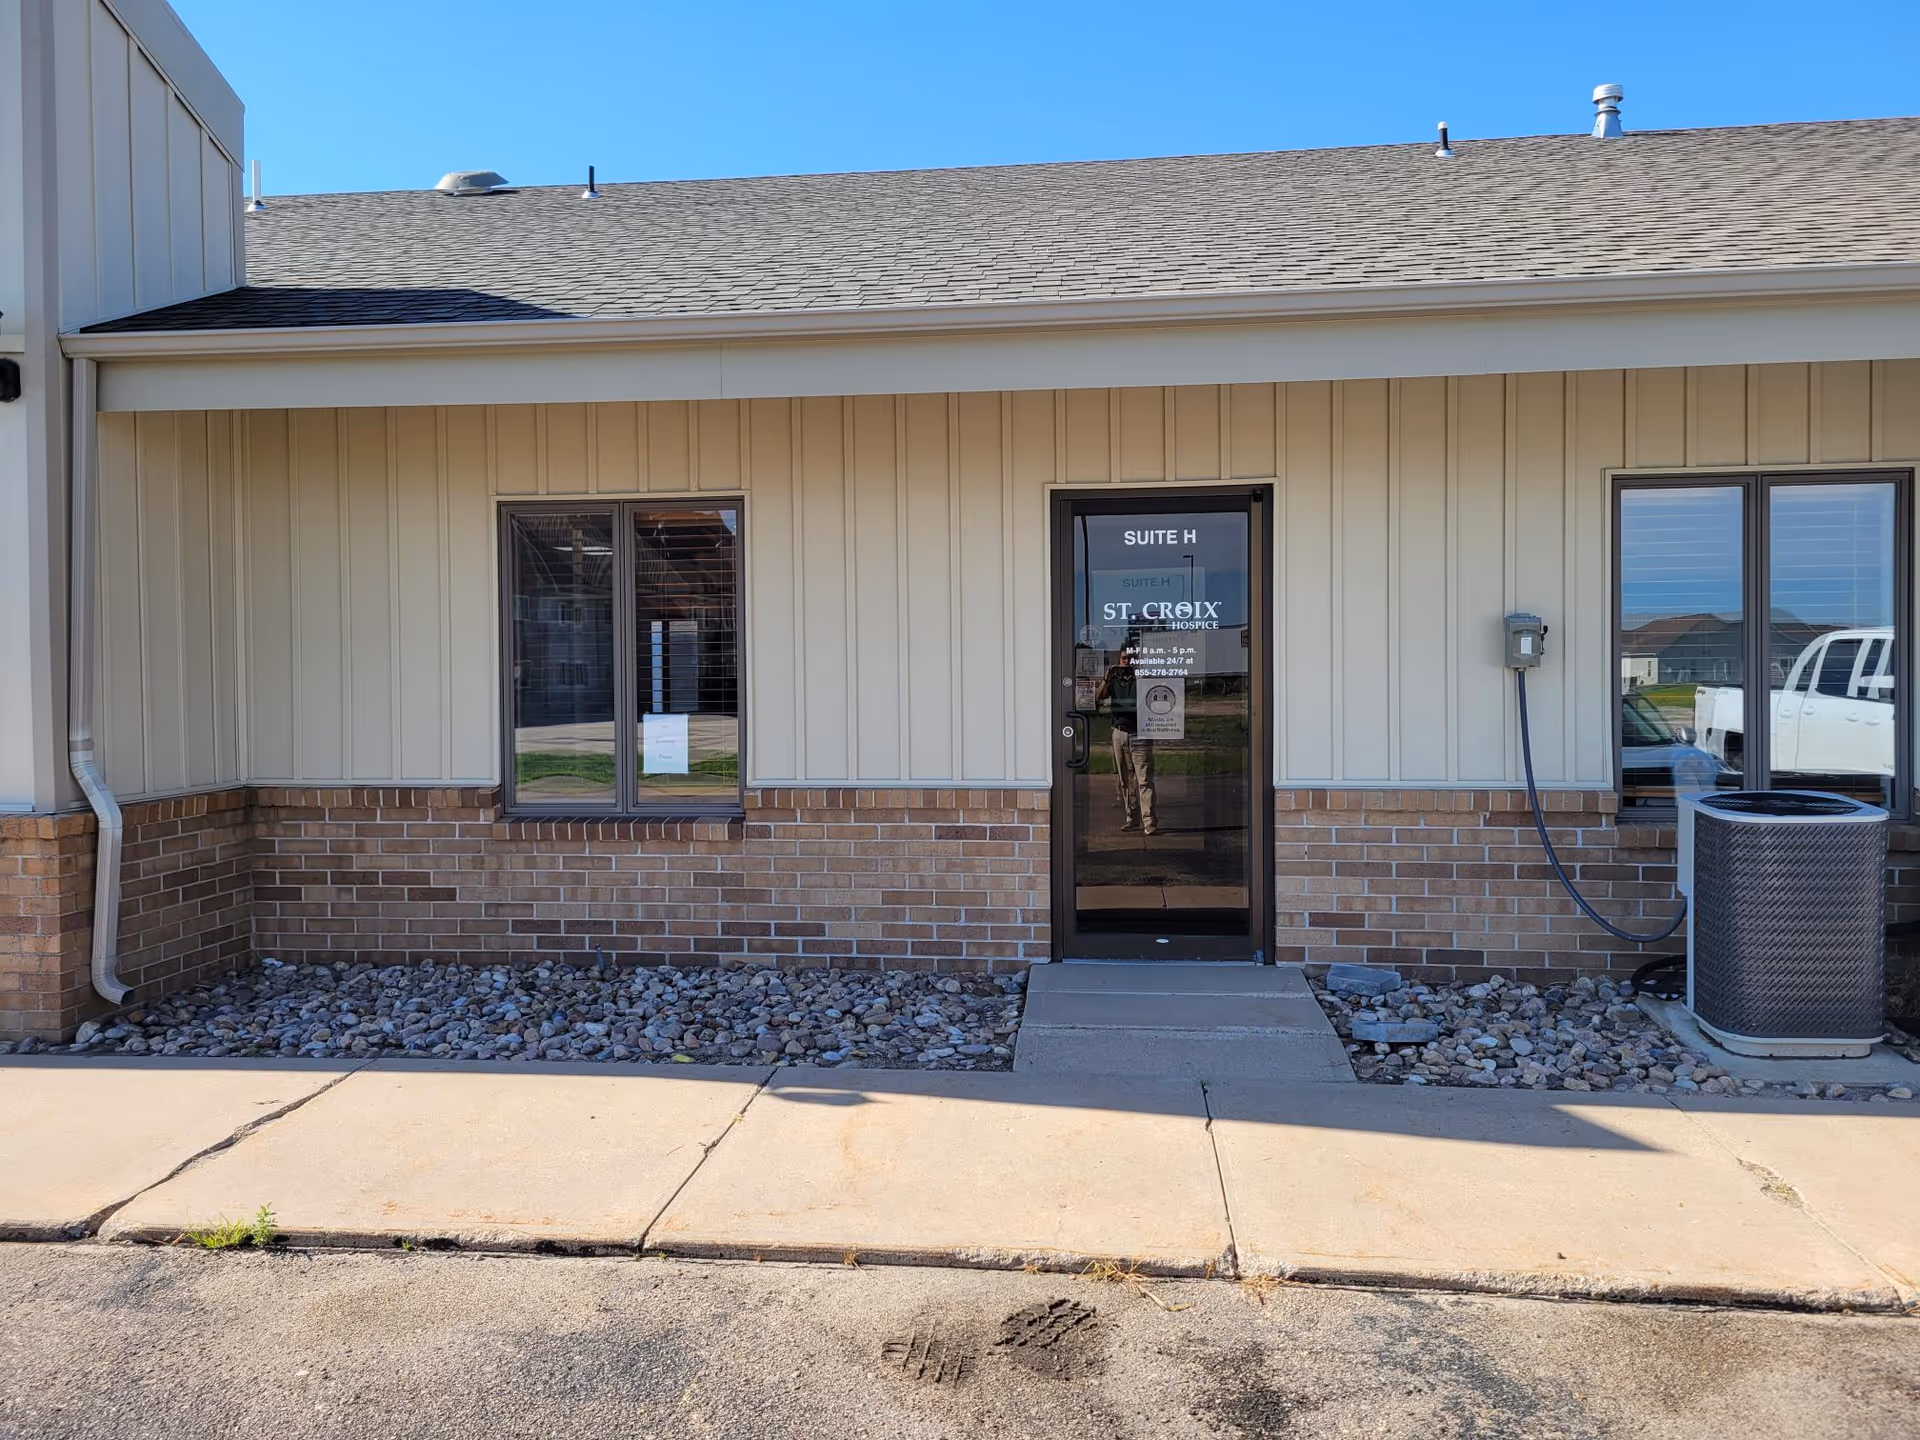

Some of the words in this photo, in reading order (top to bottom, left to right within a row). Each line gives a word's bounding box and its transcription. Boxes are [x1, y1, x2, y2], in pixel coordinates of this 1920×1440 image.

[1124, 530, 1178, 545] SUITE
[1183, 529, 1197, 544] H
[1121, 578, 1158, 588] SUITE
[1161, 577, 1171, 587] H
[1103, 602, 1137, 620] ST.
[1142, 601, 1219, 619] CROIX
[1172, 620, 1219, 630] HOSPICE
[1172, 646, 1178, 654] 5
[1129, 657, 1165, 665] Available
[1166, 657, 1184, 665] 24/7
[1134, 668, 1188, 676] 855-278-2764
